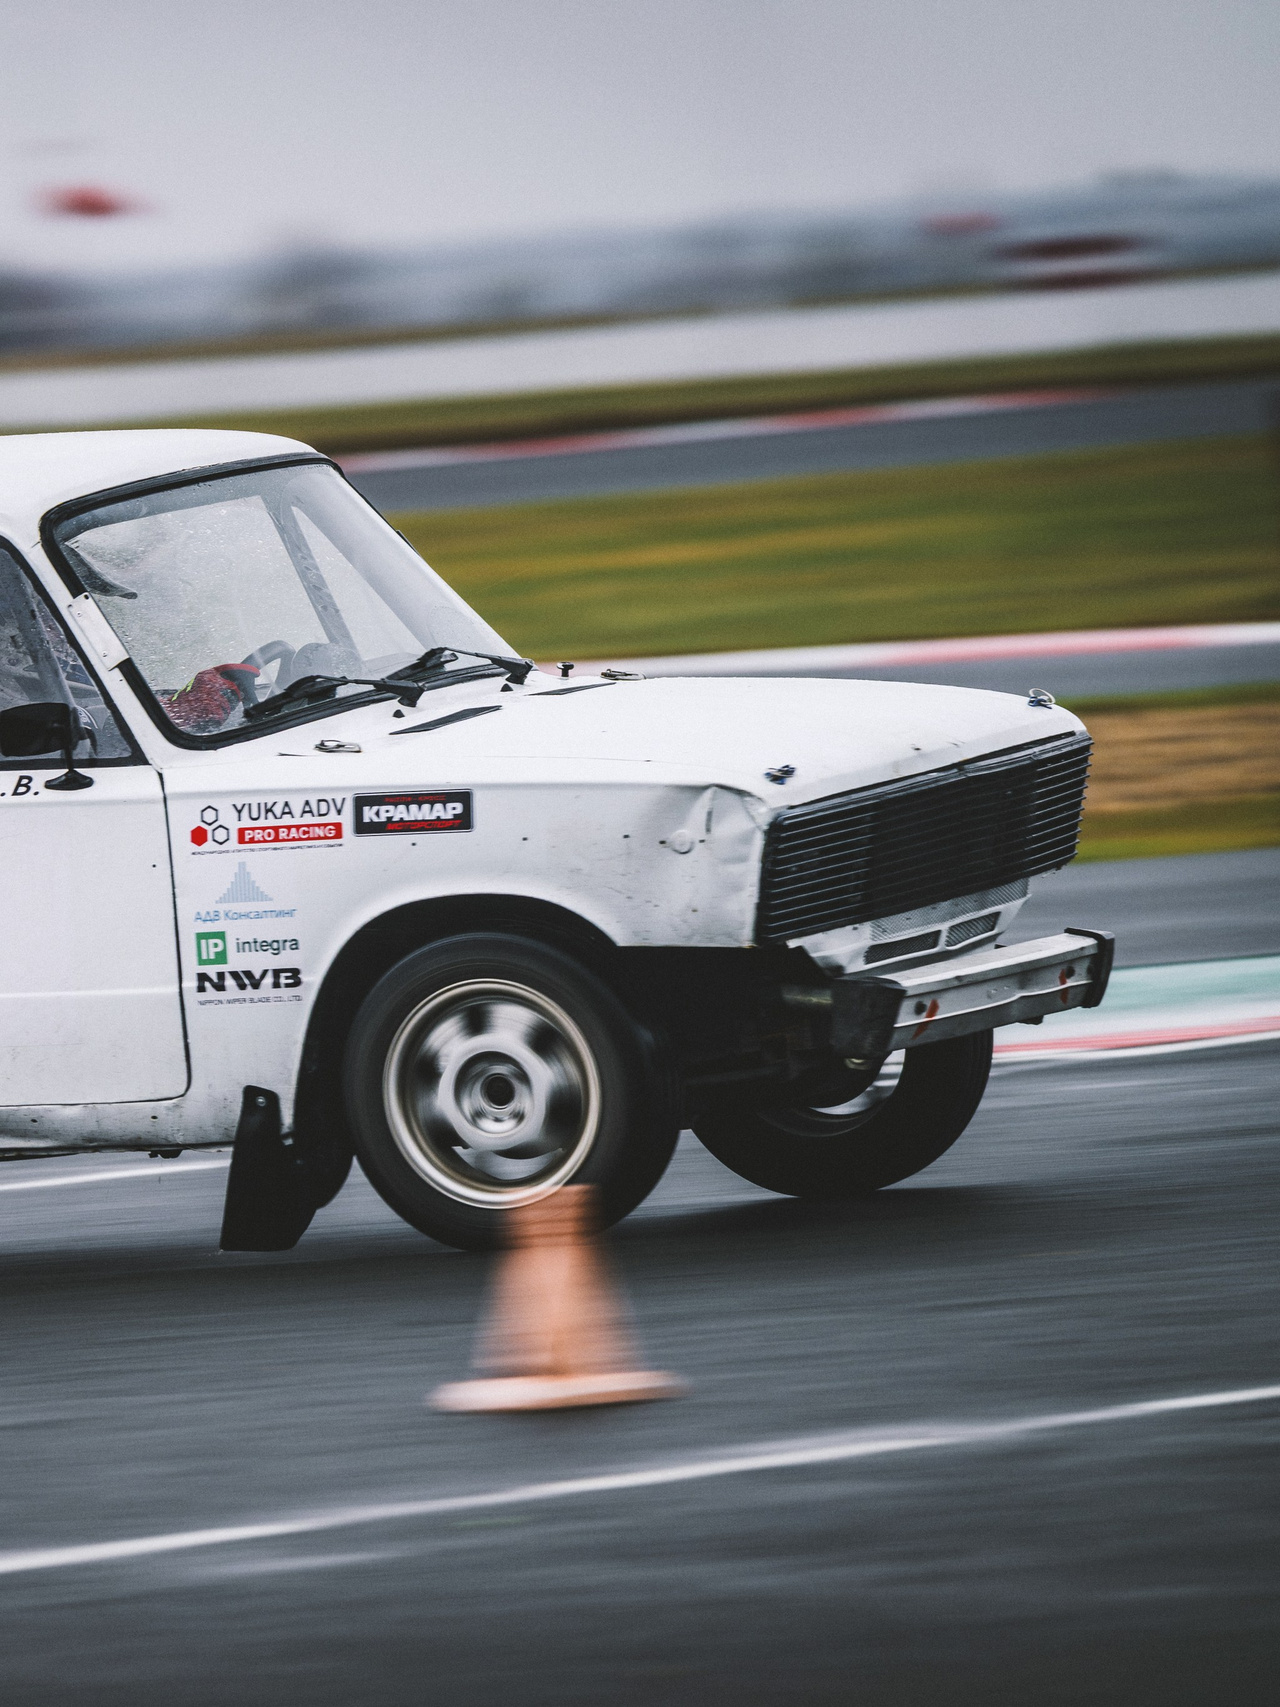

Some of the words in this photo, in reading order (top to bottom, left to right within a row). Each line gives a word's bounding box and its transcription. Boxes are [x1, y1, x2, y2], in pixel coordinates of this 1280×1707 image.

[232, 800, 295, 822] YUKA
[300, 797, 346, 818] ADV
[362, 802, 464, 823] КРАМАР
[244, 829, 275, 842] PRO
[278, 825, 337, 840] RACING
[194, 910, 221, 923] АДВ
[223, 908, 298, 921] Консалтинг
[200, 938, 225, 960] IP
[235, 937, 300, 956] integra
[196, 967, 303, 993] NWB
